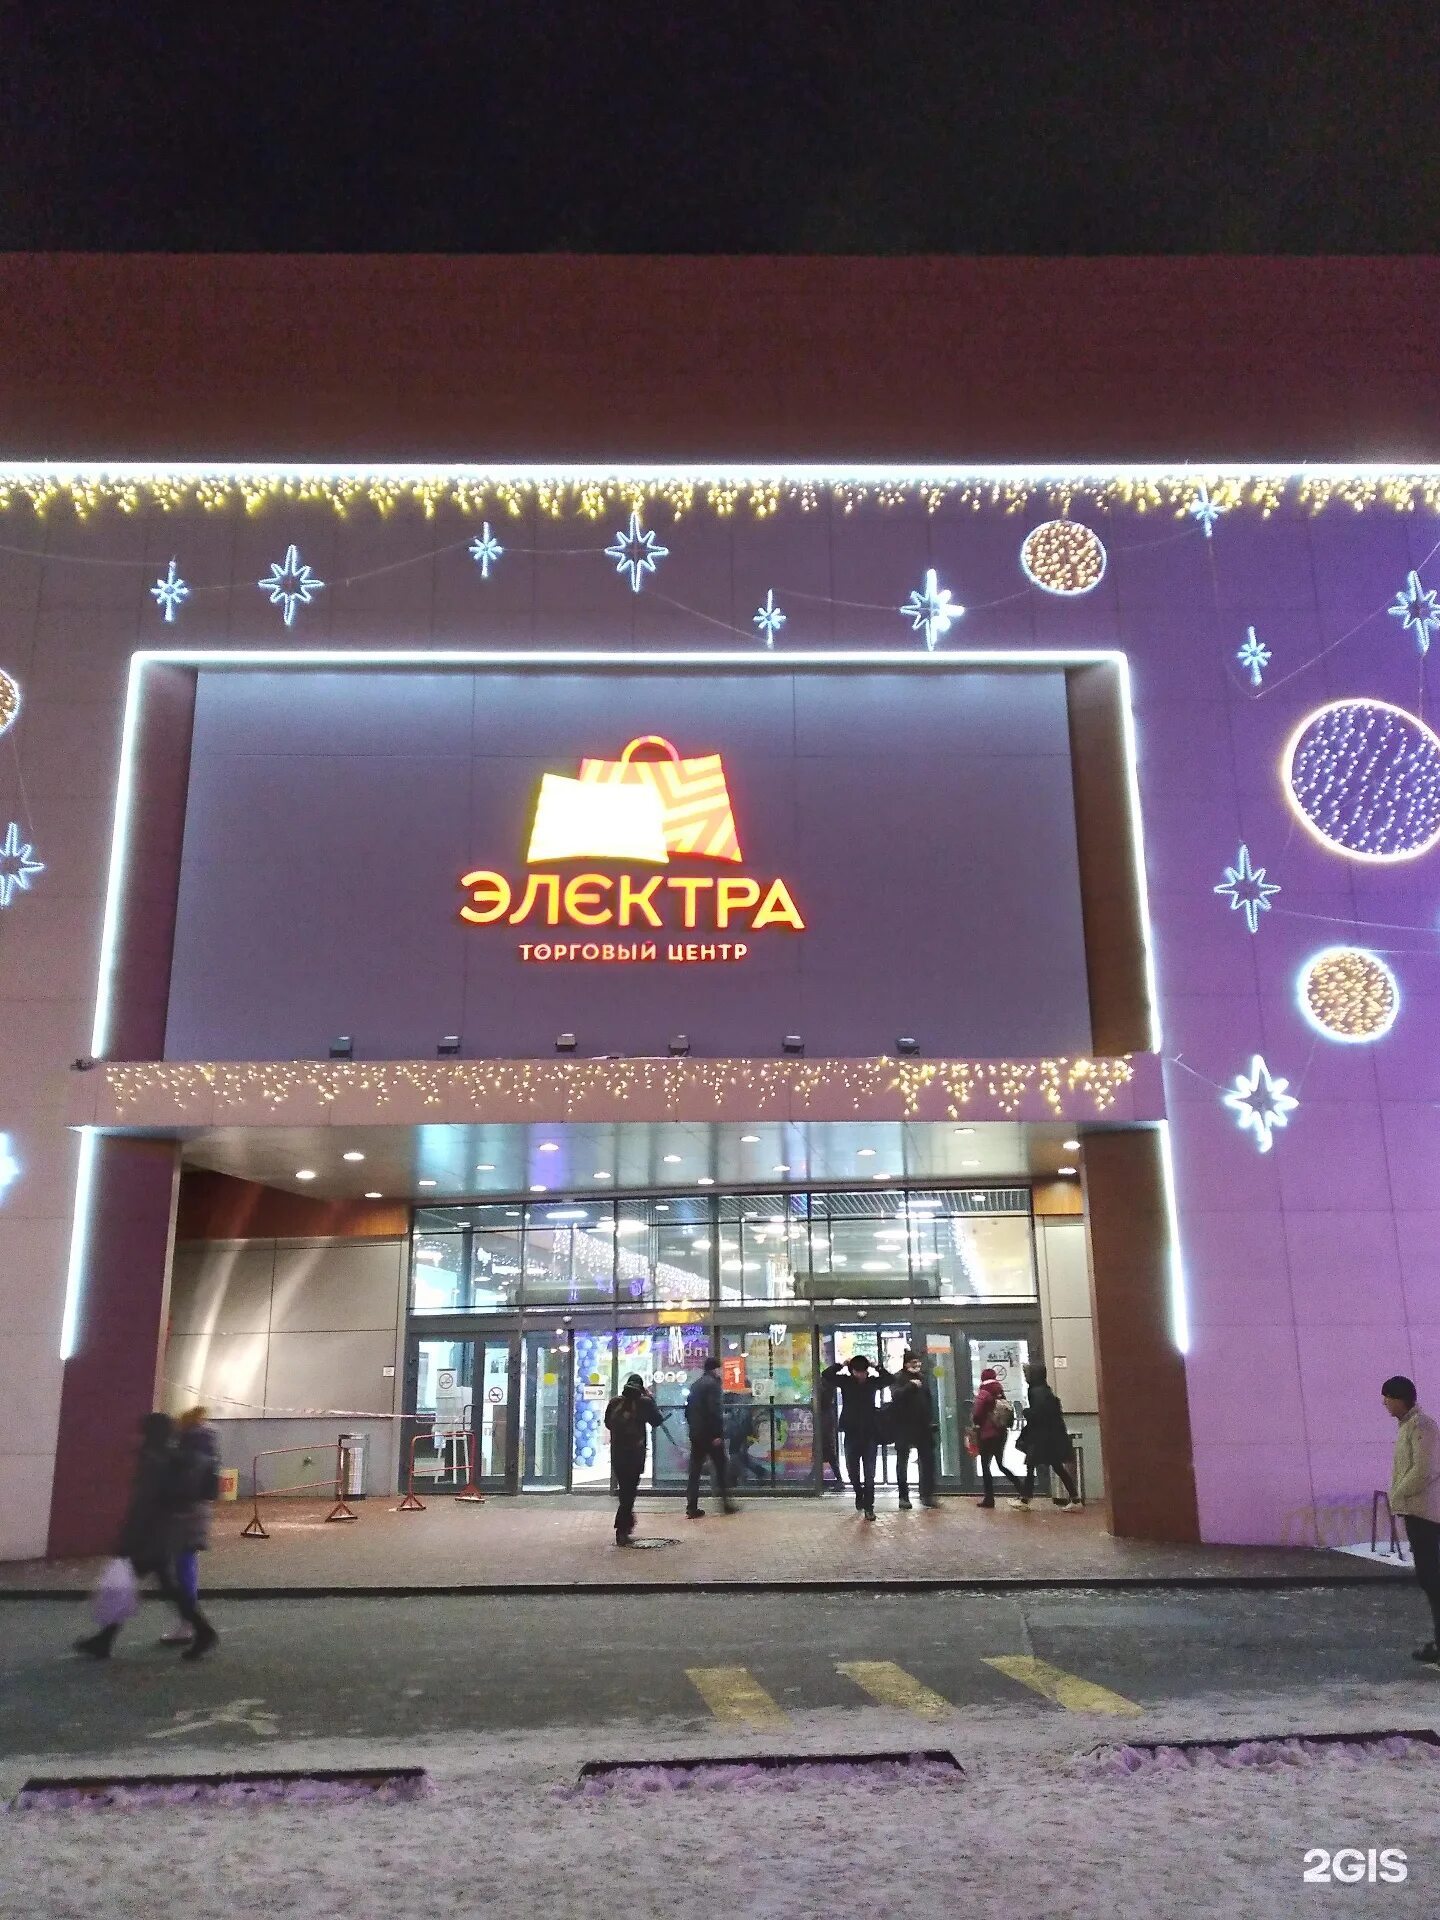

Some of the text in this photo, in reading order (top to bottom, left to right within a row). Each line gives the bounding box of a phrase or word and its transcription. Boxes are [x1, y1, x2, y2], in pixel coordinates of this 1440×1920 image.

[459, 870, 805, 930] ЭЛЕКТРА
[518, 941, 748, 962] ТОРГОВЫЙ ЦЕНТР
